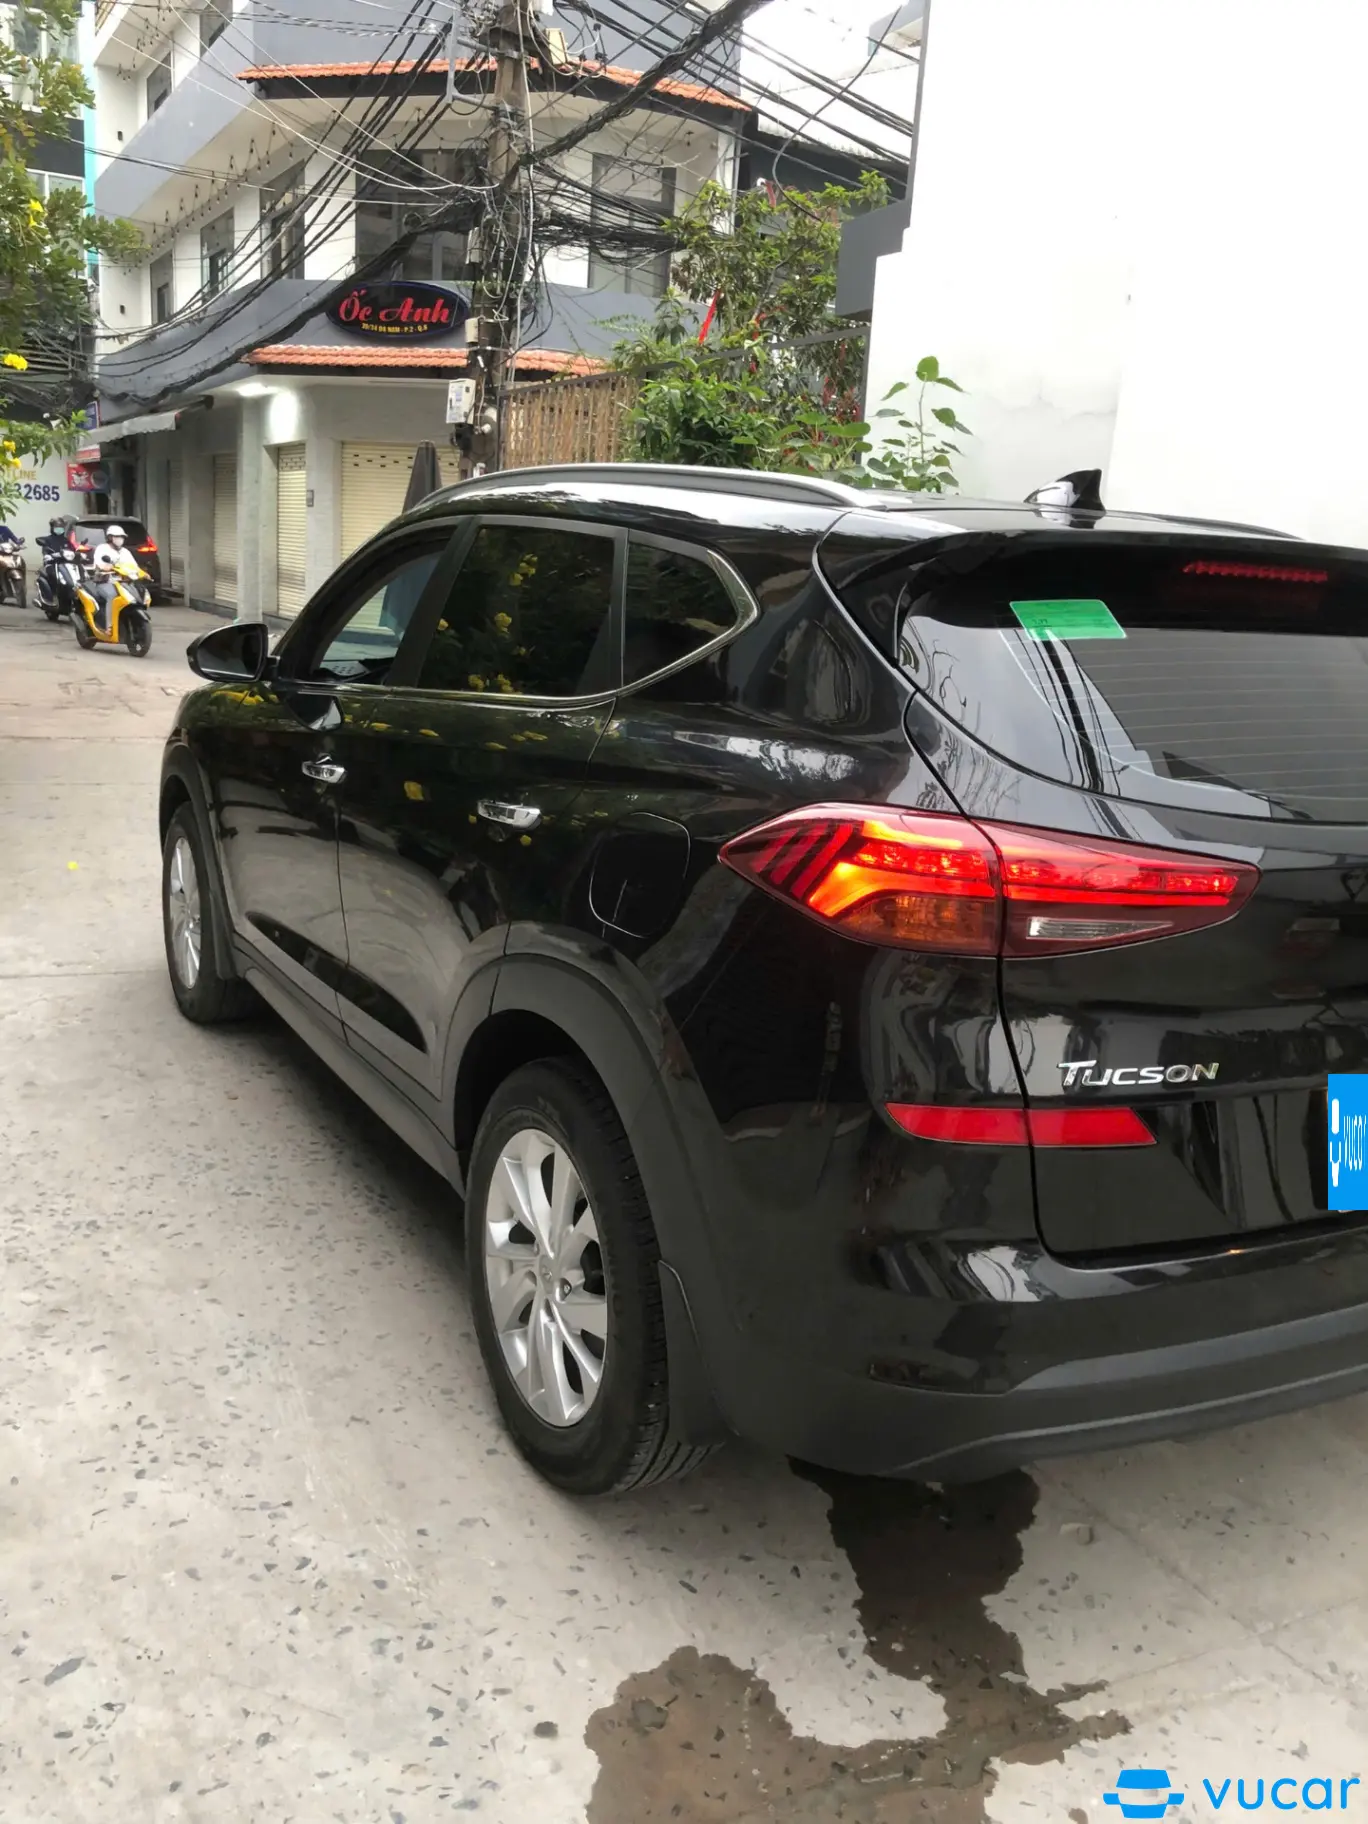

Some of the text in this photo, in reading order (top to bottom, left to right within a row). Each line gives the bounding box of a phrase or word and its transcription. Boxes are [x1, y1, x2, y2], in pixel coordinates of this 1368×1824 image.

[339, 288, 450, 323] Ốc Anh
[1056, 1059, 1220, 1086] TUCSON
